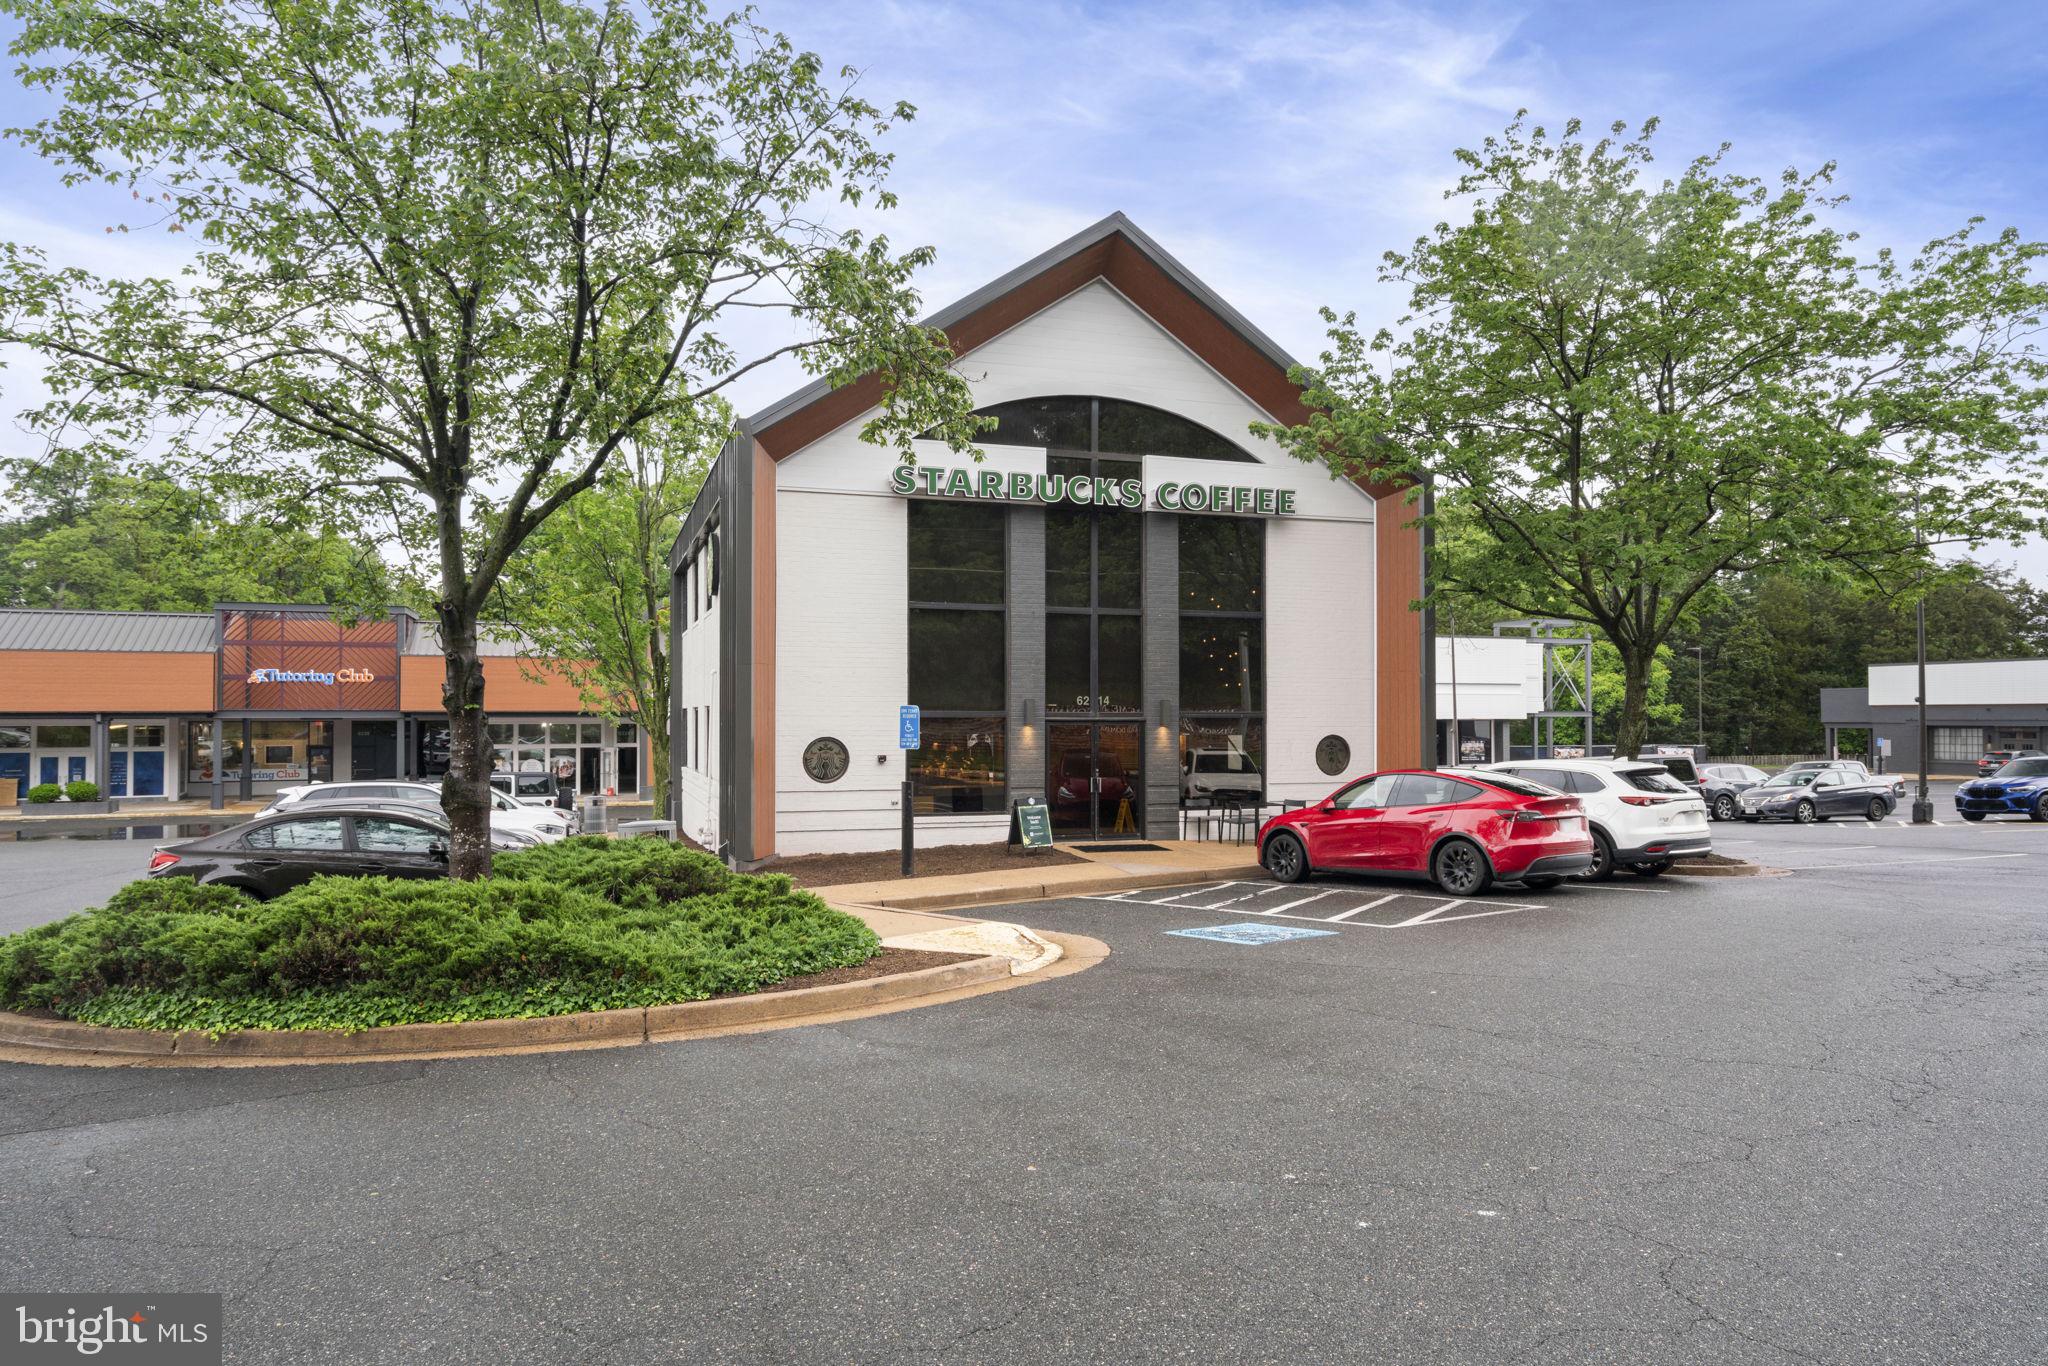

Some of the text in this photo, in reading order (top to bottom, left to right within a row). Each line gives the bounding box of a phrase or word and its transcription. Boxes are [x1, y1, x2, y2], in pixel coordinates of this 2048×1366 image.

[892, 464, 1297, 515] STARBUCKS COFFEE
[264, 668, 374, 685] Tutoring Club
[276, 769, 300, 779] Club
